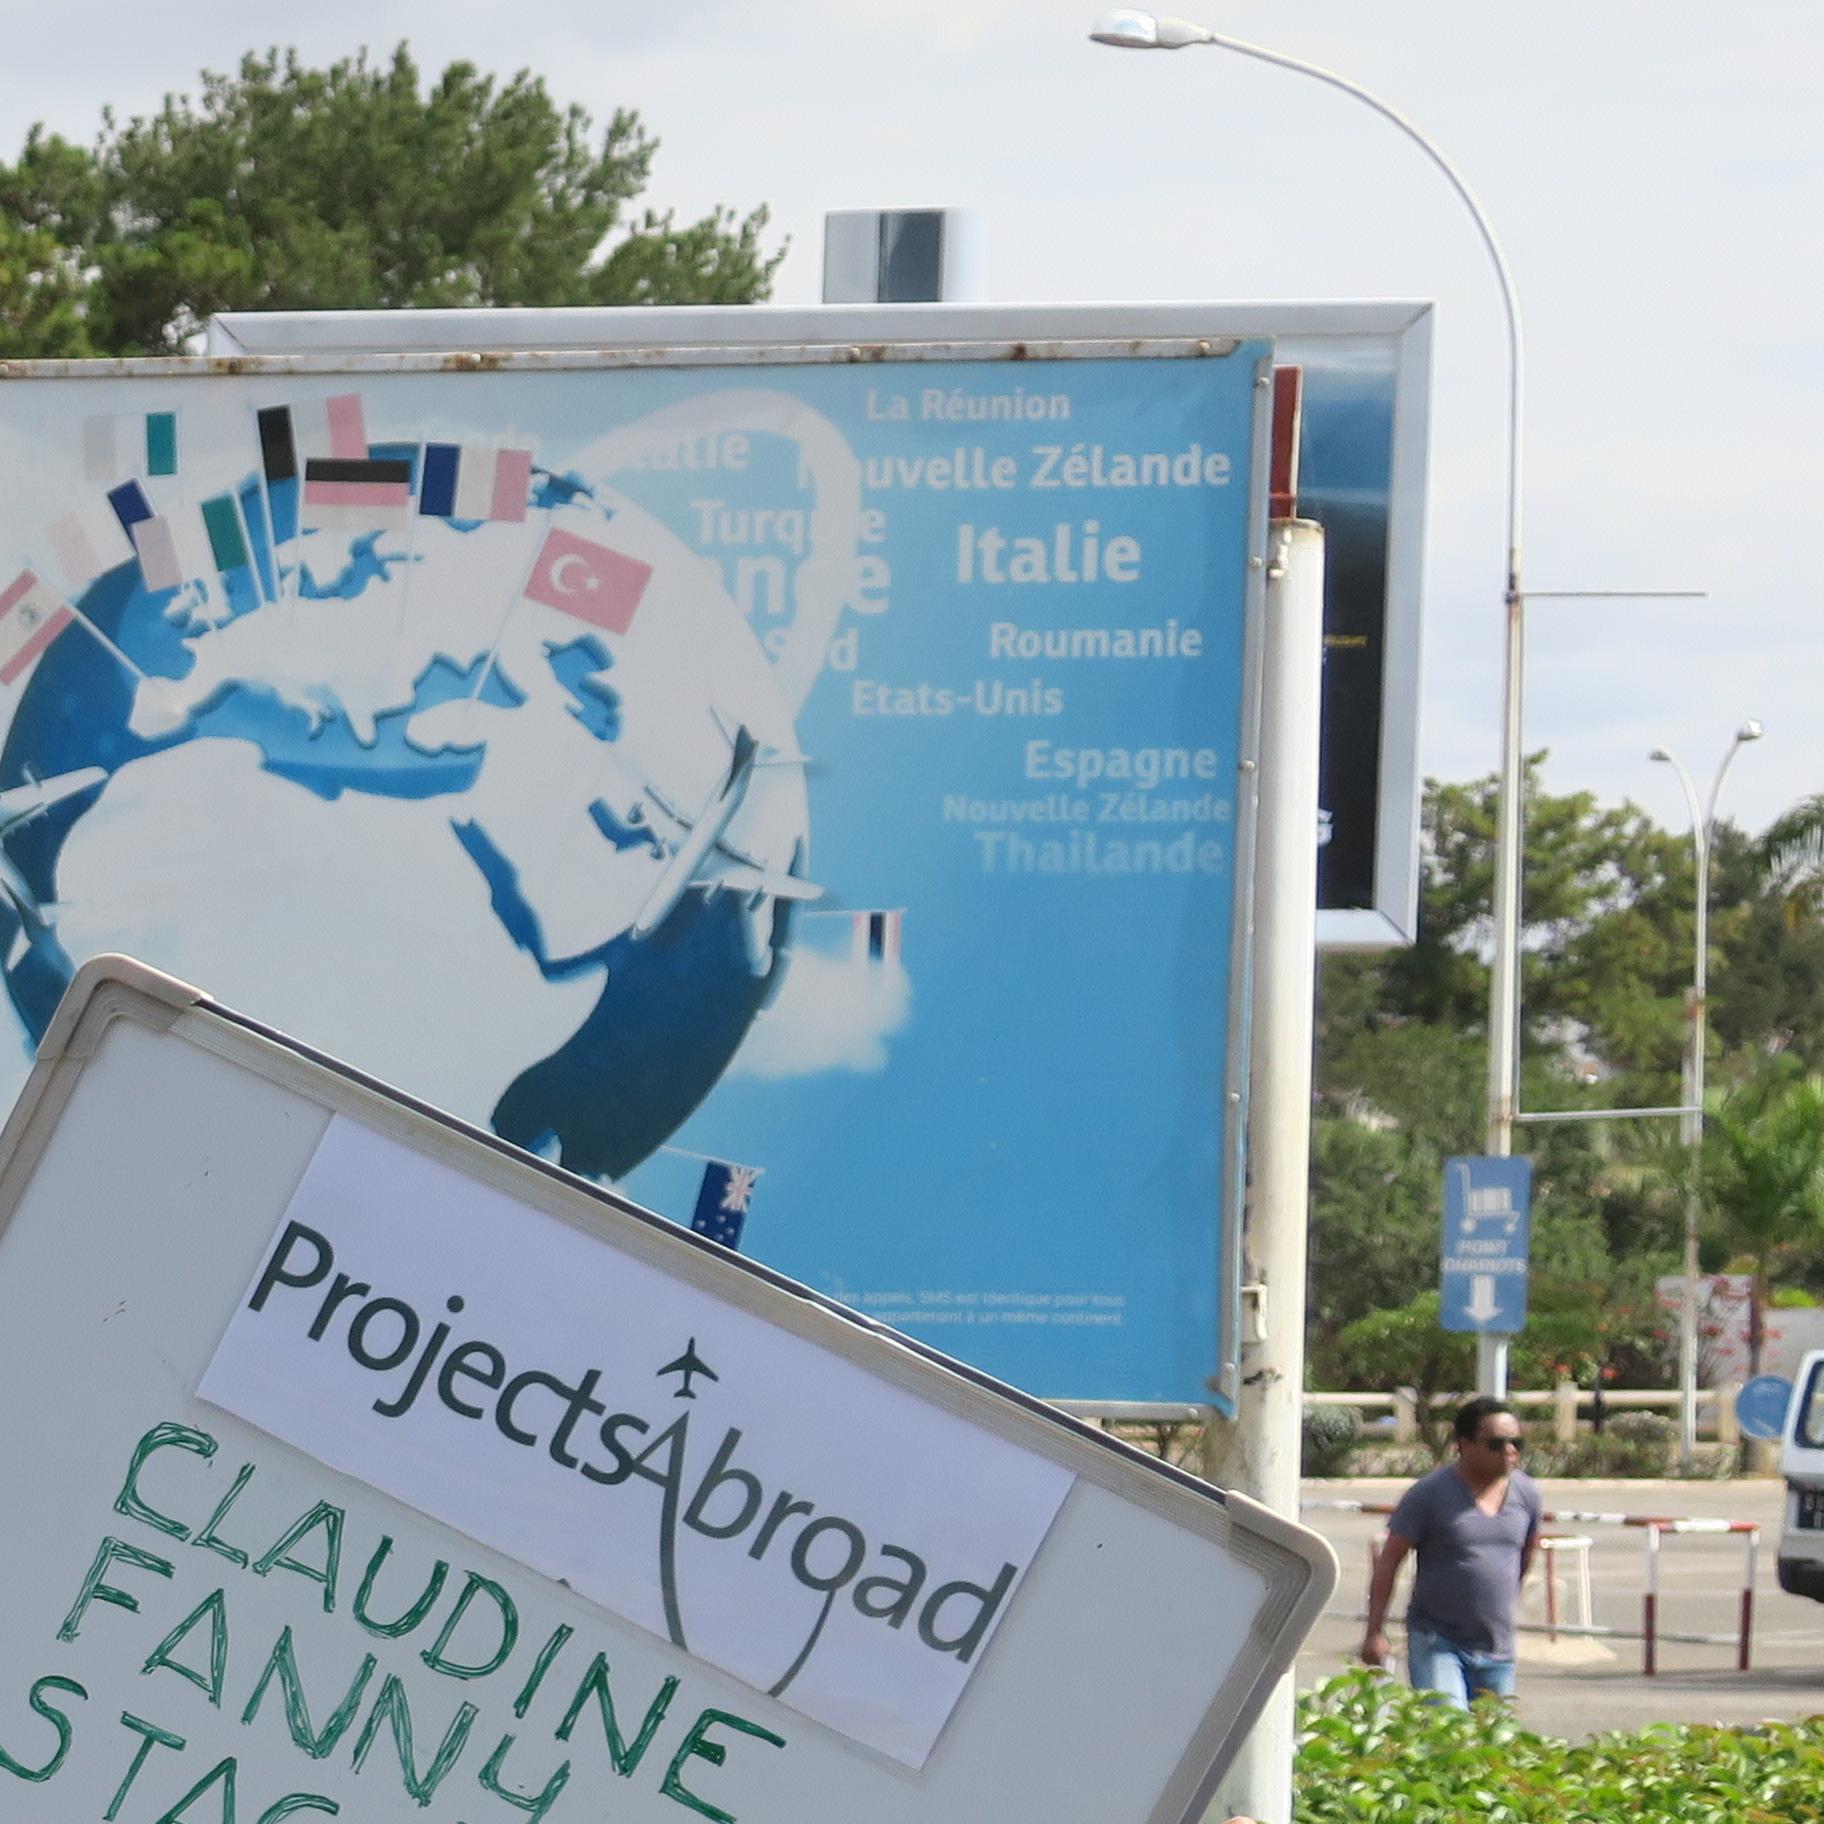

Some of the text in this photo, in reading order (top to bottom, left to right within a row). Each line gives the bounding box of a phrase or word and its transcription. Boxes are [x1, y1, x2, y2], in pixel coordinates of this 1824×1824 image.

[866, 388, 1071, 421] La Réunion
[1030, 443, 1232, 488] Zélande
[691, 500, 886, 556] Turqe
[957, 520, 1142, 585] Italie
[990, 619, 1204, 659] Roumanie
[852, 680, 1065, 716] Etats-Unis
[1025, 740, 1218, 788] Espagne
[942, 791, 1232, 824] Nouvelle Zélande
[973, 829, 1224, 875] Thailande
